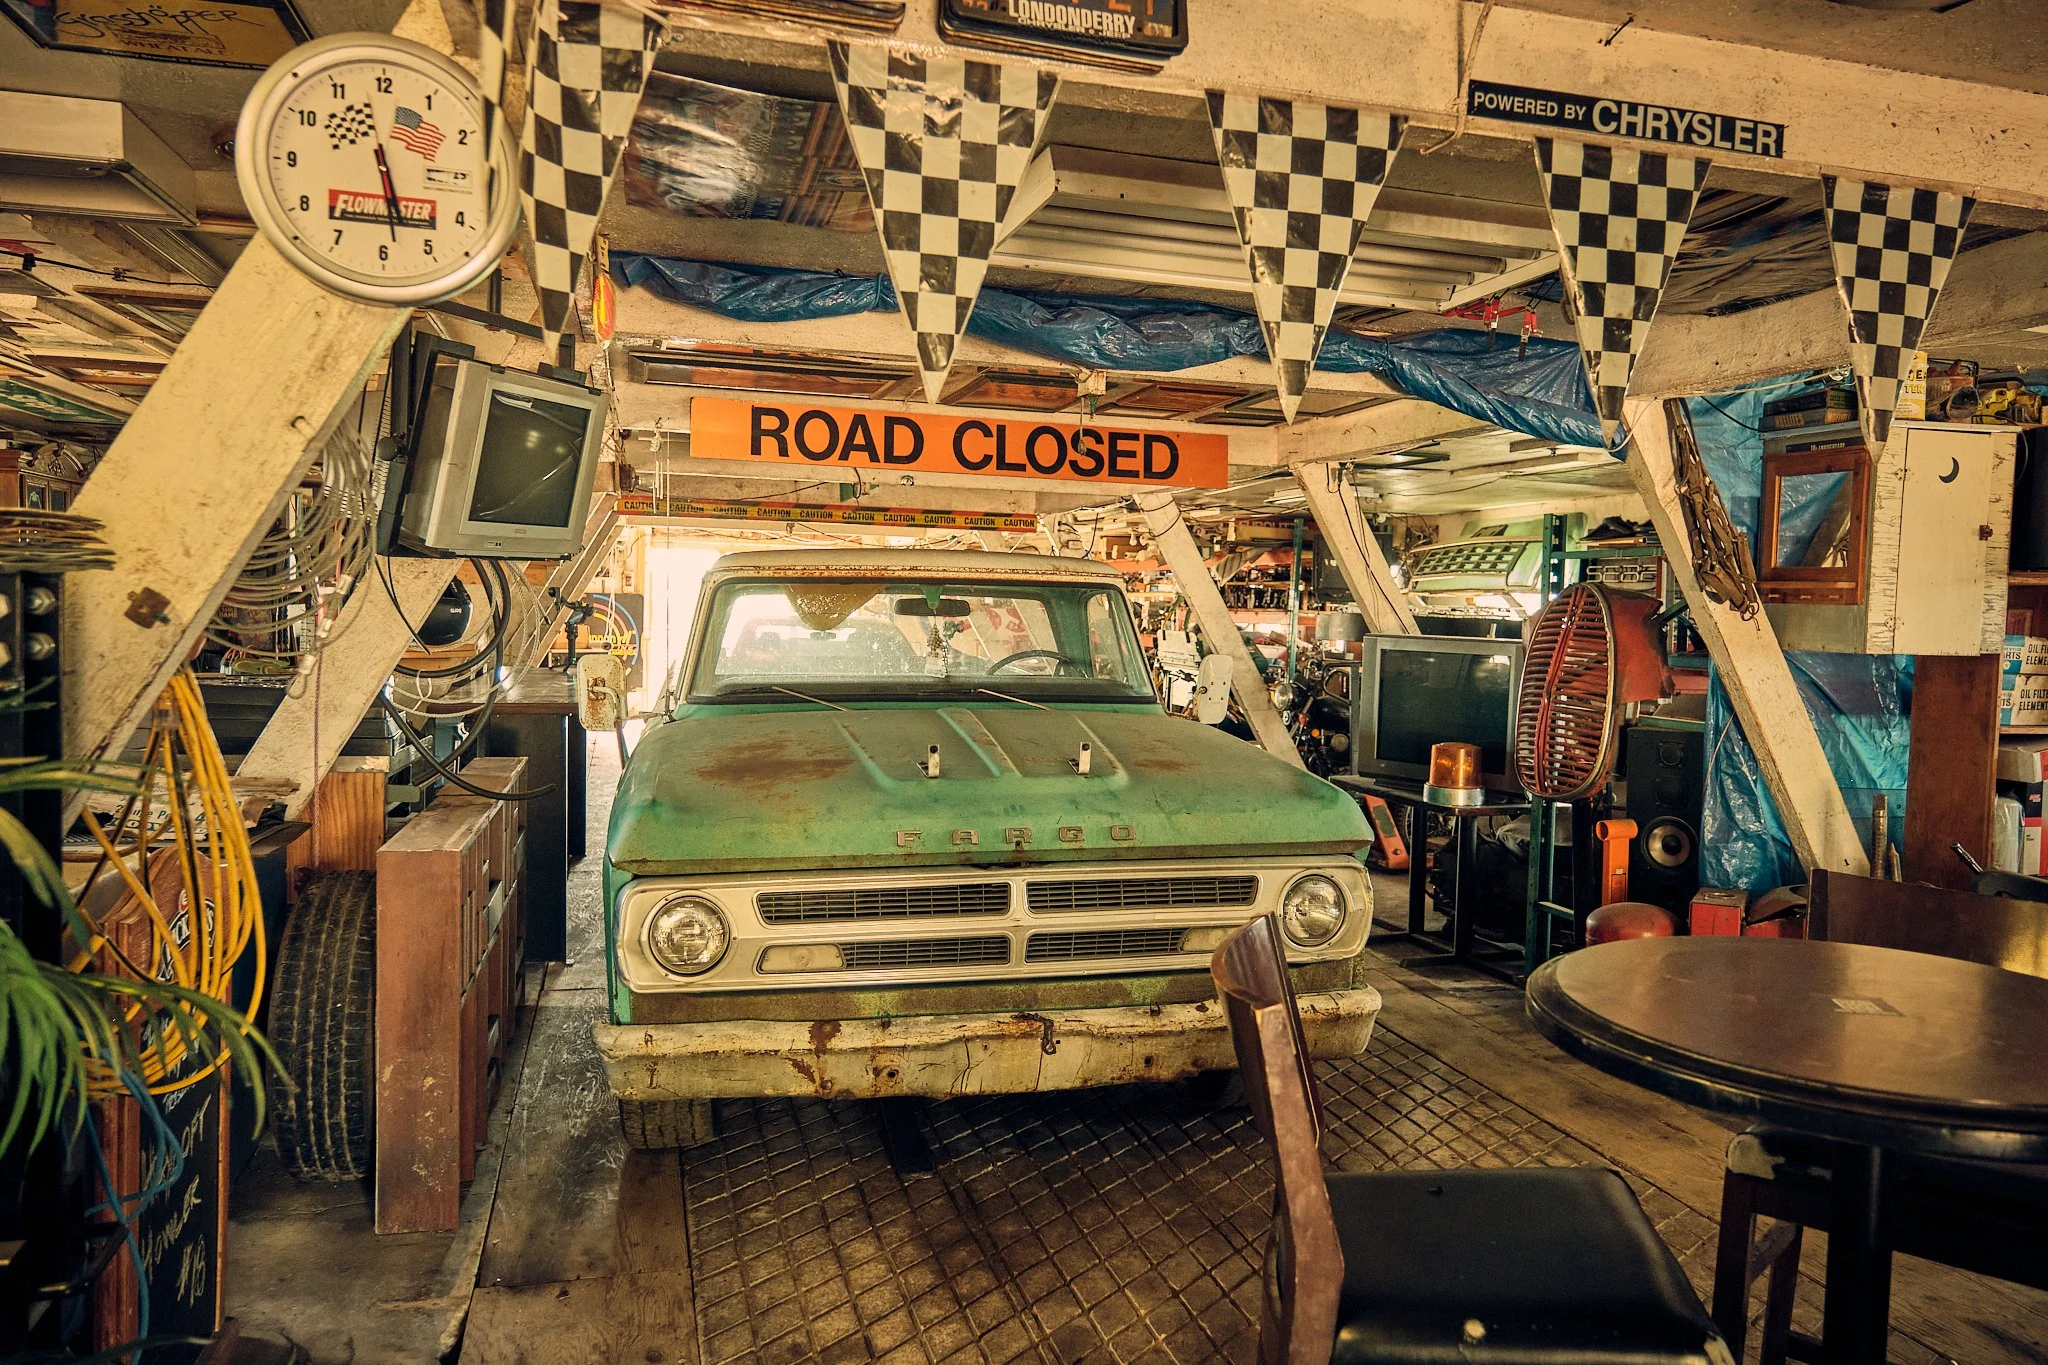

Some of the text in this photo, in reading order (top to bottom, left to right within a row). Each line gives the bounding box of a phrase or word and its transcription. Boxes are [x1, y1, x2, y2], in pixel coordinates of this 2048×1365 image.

[1008, 0, 1135, 35] LONDONDERRY
[331, 83, 345, 99] 11
[376, 77, 393, 94] 12
[425, 95, 432, 110] 1
[298, 110, 316, 127] 10
[1473, 91, 1778, 156] POWERED BY CHRYSLER
[458, 129, 468, 146] 2
[287, 151, 297, 167] 9
[300, 195, 309, 211] 8
[455, 211, 465, 227] 4
[333, 229, 343, 245] 7
[379, 245, 388, 261] 6
[424, 239, 433, 255] 5
[750, 404, 1180, 481] ROAD CLOSED
[757, 508, 791, 518] CAUTION
[800, 510, 833, 520] CAUTION
[842, 511, 875, 521] CAUTION
[884, 513, 916, 523] CAUTION
[924, 515, 956, 525] CAUTION
[964, 517, 996, 526] CAUTION
[1003, 518, 1035, 527] CAUTION
[2028, 644, 2039, 654] OIL
[2020, 689, 2031, 699] OIL
[896, 824, 1137, 847] FARGO
